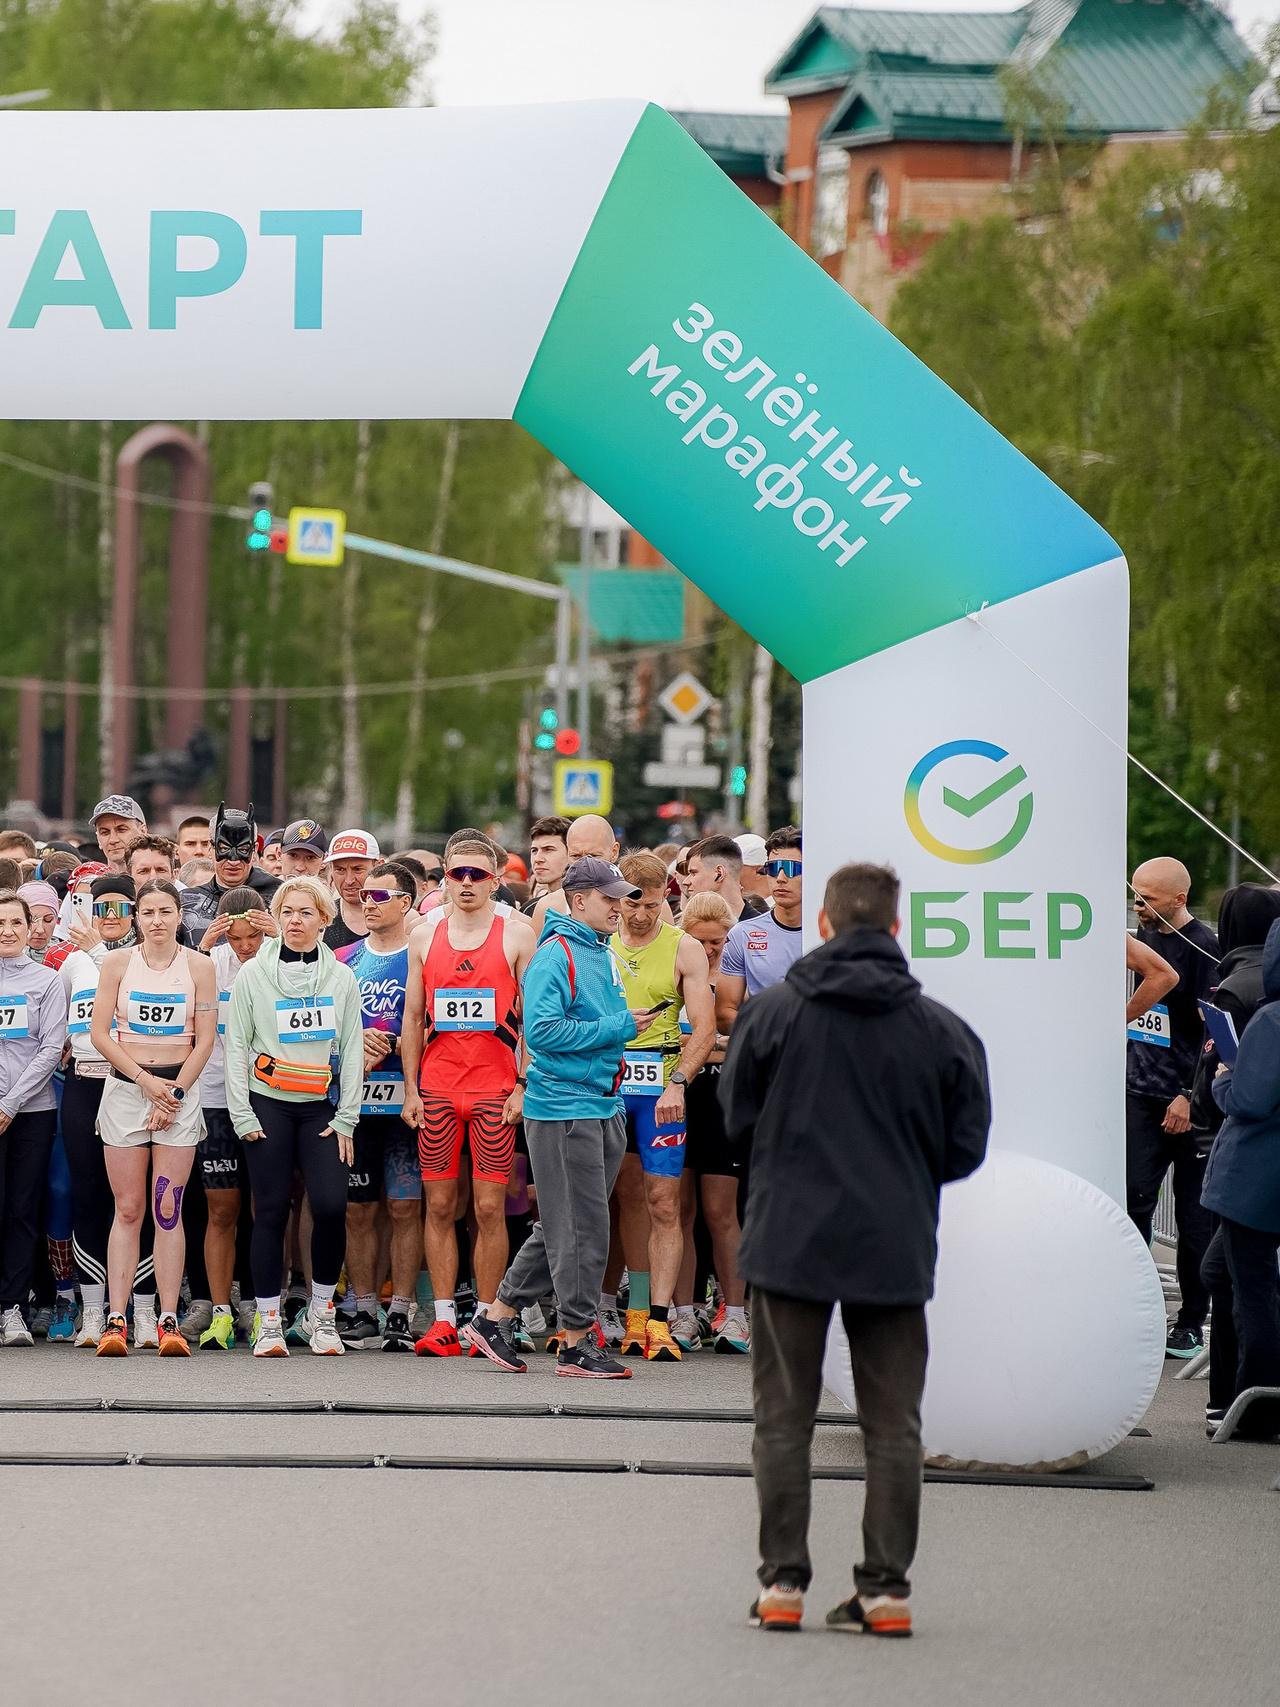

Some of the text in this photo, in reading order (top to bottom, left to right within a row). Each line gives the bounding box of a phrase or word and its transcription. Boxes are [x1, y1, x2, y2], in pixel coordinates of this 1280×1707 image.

[672, 302, 923, 526] зелёный
[626, 343, 869, 568] марафон
[333, 838, 366, 853] ciele
[909, 891, 1093, 960] БЕР
[77, 1001, 94, 1019] 52
[139, 1004, 175, 1023] 587
[361, 994, 401, 1017] RUN
[446, 1001, 483, 1018] 812
[289, 1009, 323, 1029] 681
[623, 1064, 658, 1082] 055
[362, 1084, 395, 1101] 747
